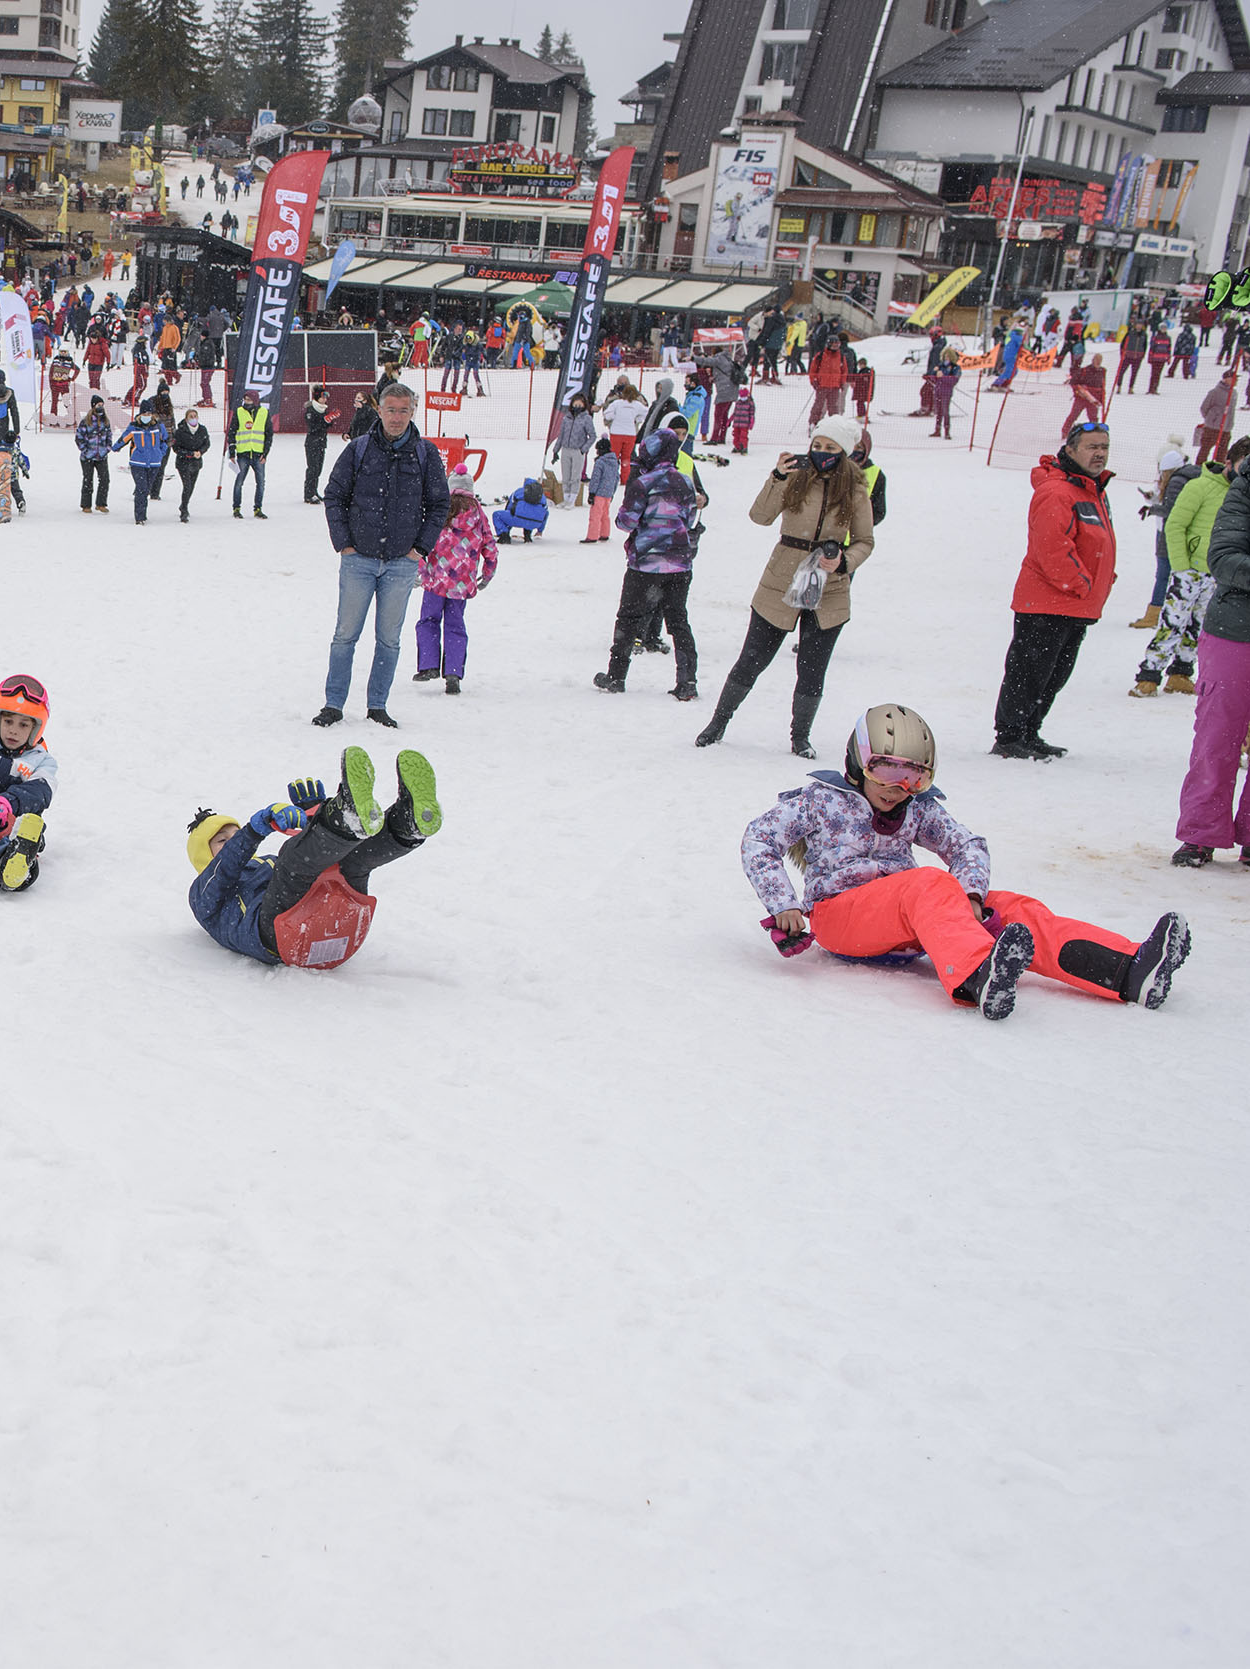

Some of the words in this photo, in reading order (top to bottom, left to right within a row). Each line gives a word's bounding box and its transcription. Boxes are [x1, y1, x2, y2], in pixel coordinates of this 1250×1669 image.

[451, 142, 578, 170] PANORAMA
[733, 149, 767, 163] FIS
[480, 162, 502, 173] BAR
[516, 164, 546, 174] FOOD
[1023, 179, 1061, 187] DINNER
[994, 202, 1041, 220] SKI
[477, 269, 551, 282] RESTAURANT
[919, 277, 963, 321] FISCHER
